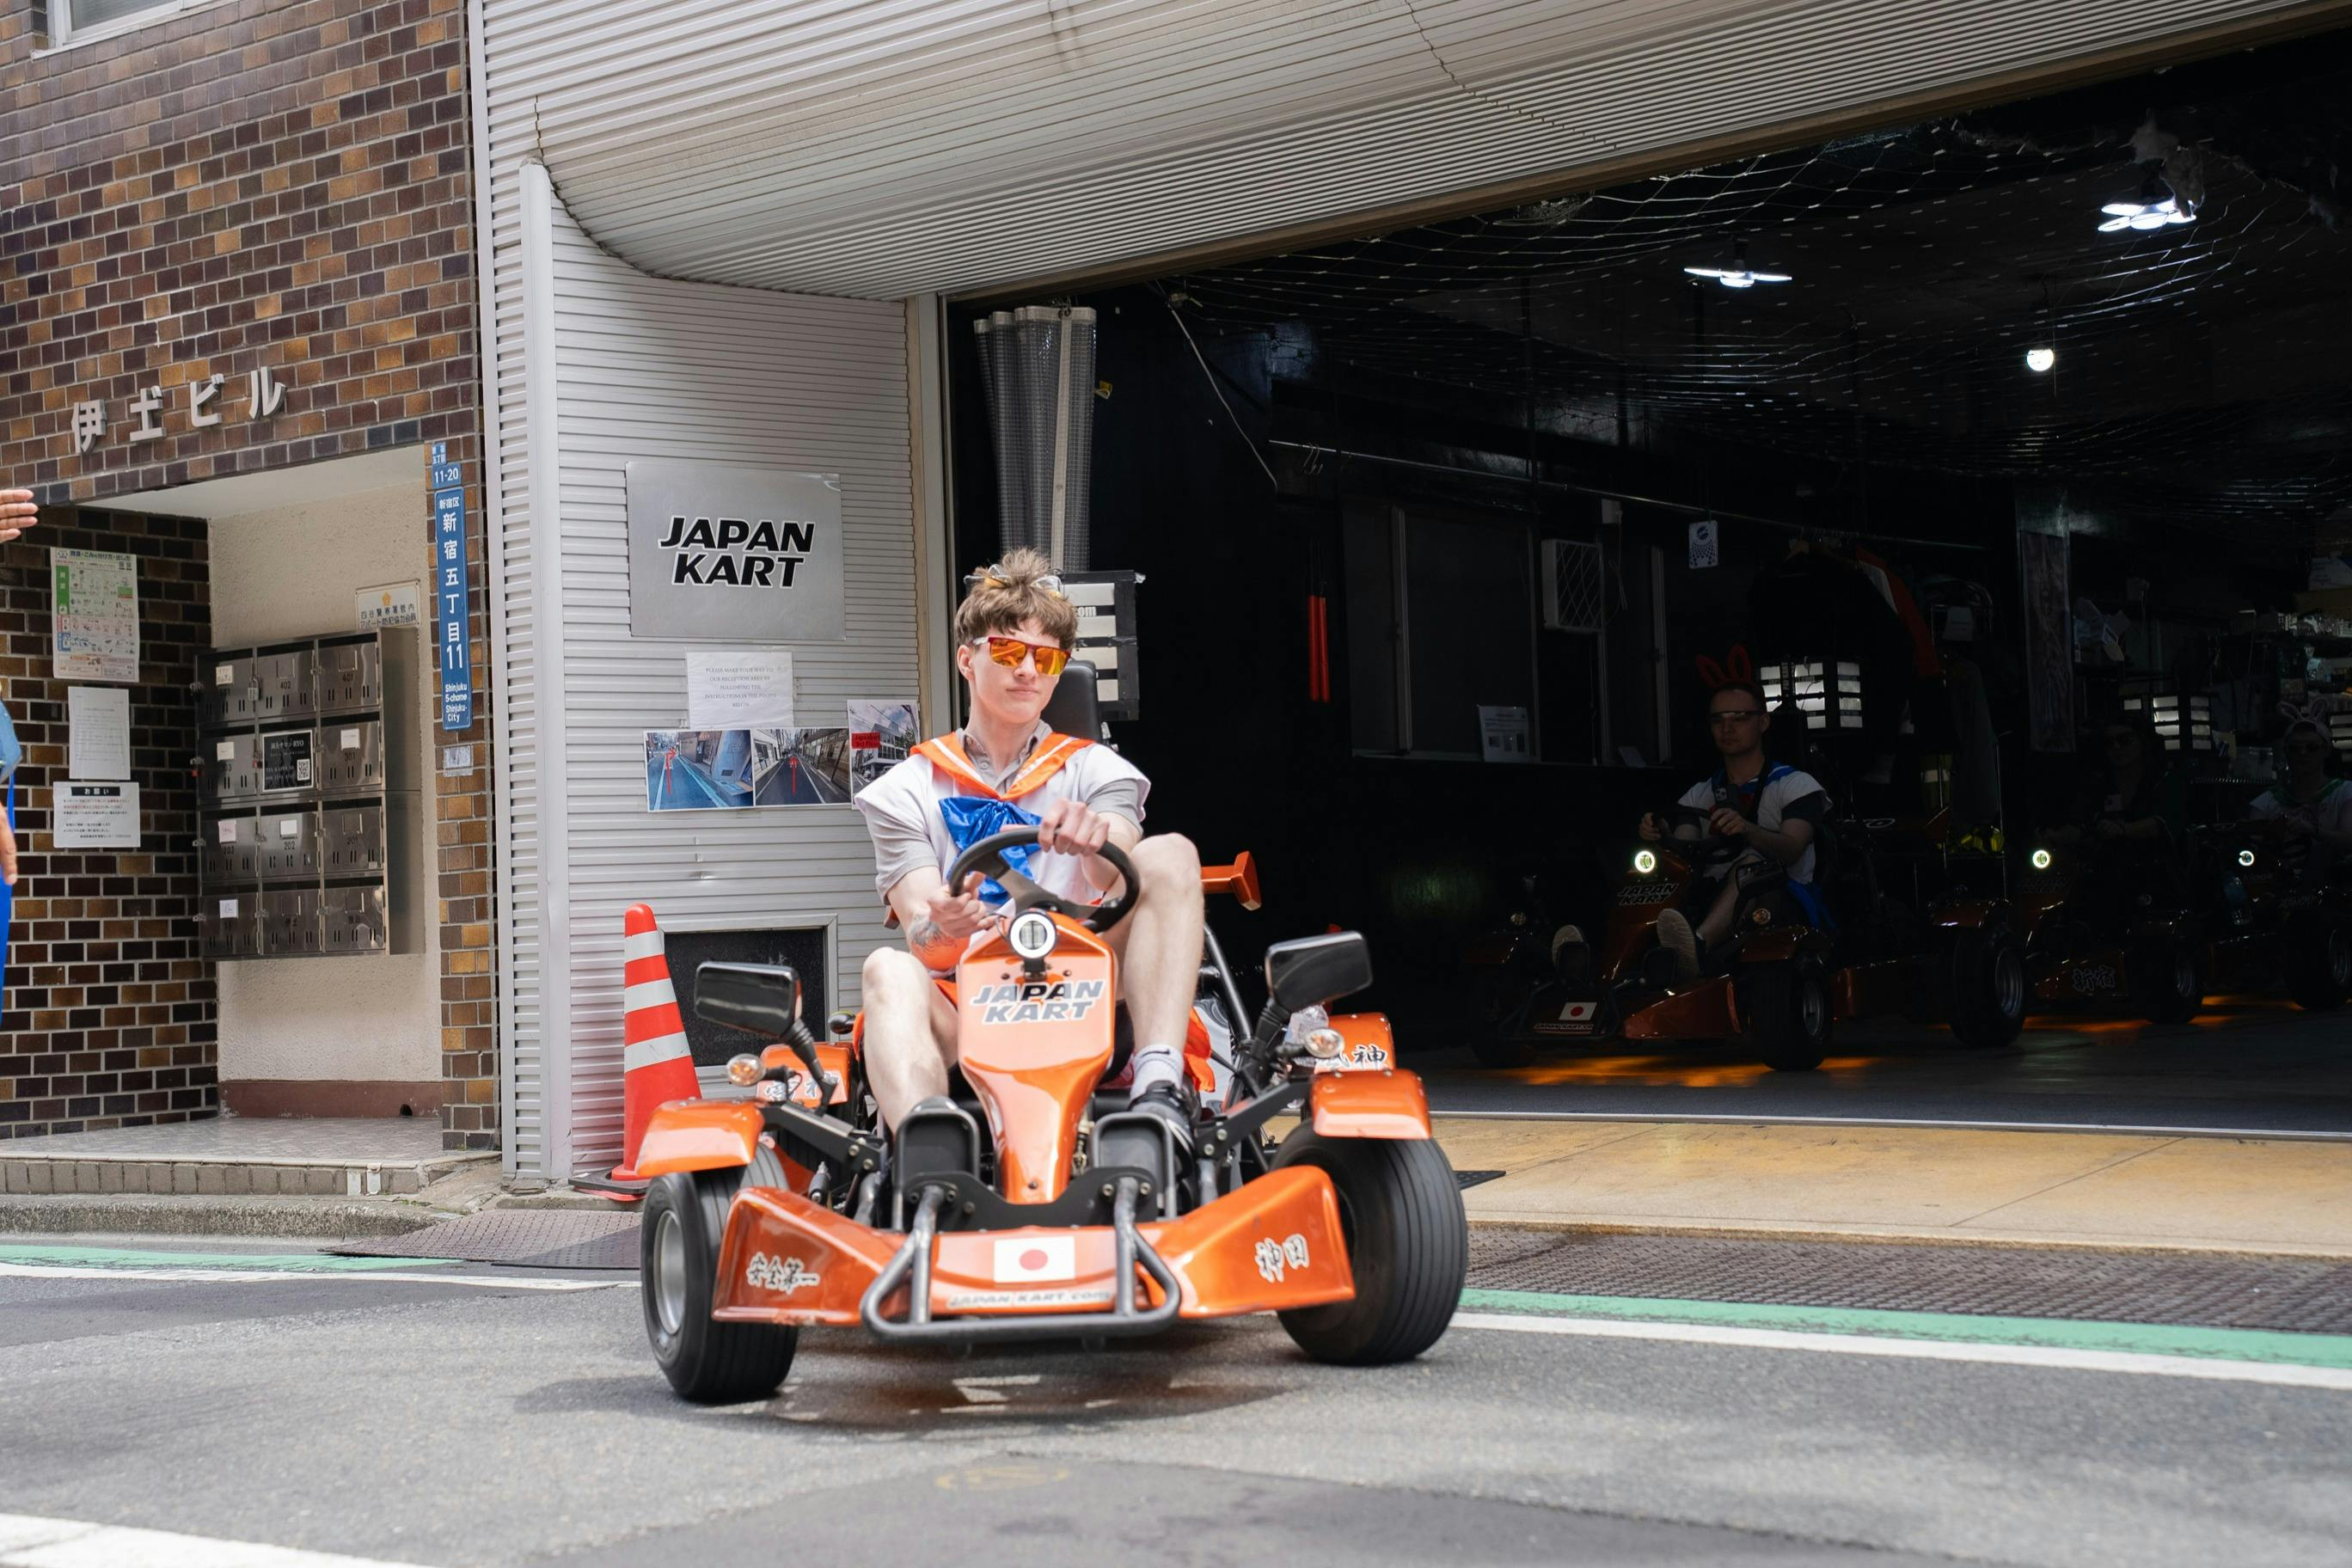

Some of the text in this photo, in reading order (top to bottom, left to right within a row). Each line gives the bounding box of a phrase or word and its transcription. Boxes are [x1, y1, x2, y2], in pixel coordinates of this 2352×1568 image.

[435, 468, 459, 483] 11-20
[439, 496, 460, 510] 新宿区
[658, 516, 816, 554] JAPAN
[672, 552, 805, 588] KART
[280, 681, 291, 689] 402
[445, 683, 468, 693] Shinjuku
[445, 693, 468, 703] 5-chome
[447, 714, 461, 723] City
[284, 841, 295, 850] 202
[1617, 883, 1680, 897] JAPAN
[1619, 893, 1671, 906] KART
[971, 979, 1105, 1006] JAPAN
[983, 1001, 1094, 1024] KART
